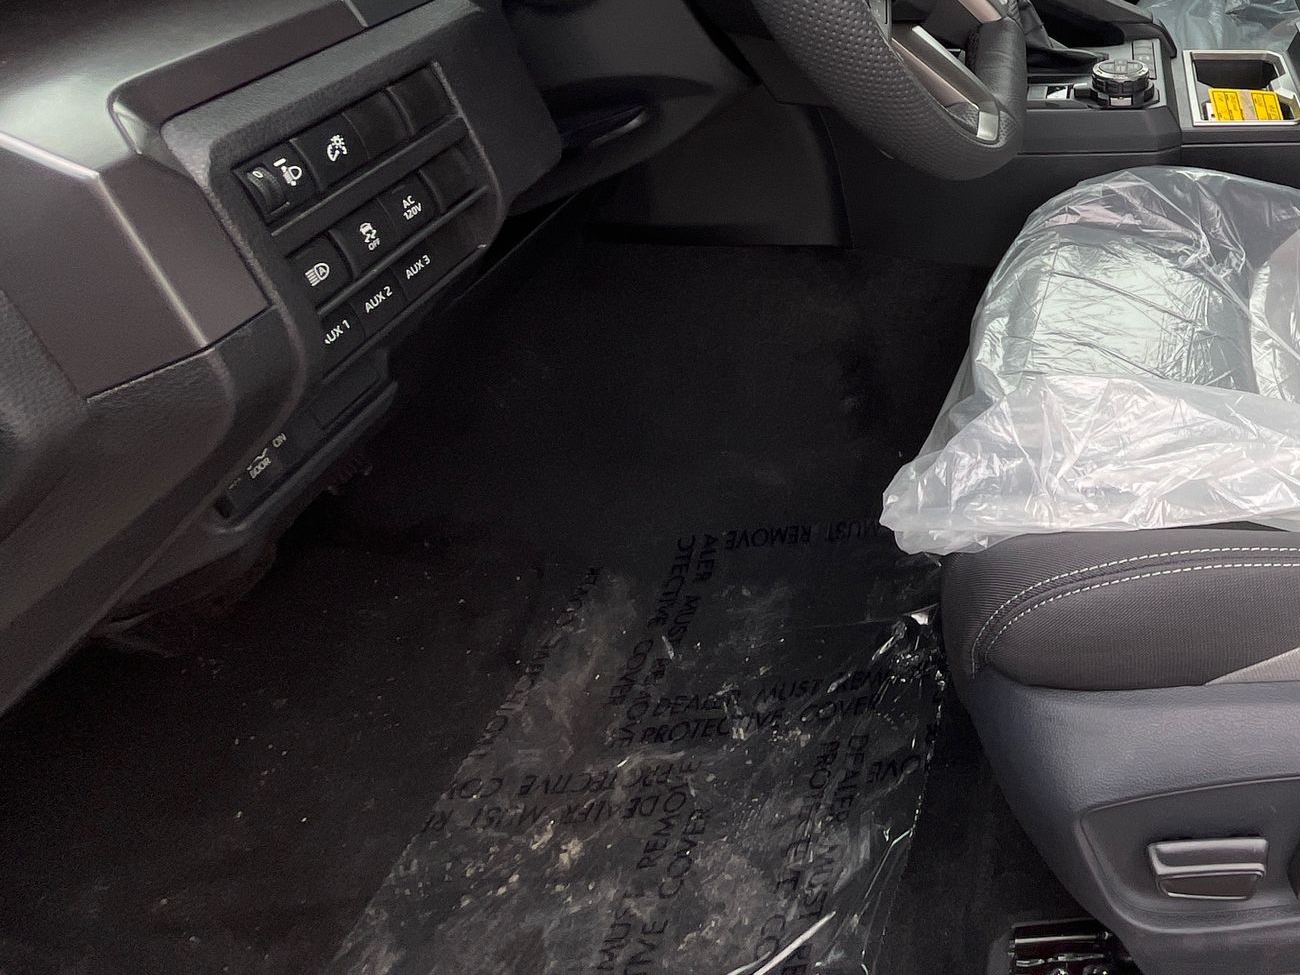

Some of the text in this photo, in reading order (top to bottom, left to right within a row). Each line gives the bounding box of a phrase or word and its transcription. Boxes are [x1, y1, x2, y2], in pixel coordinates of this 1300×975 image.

[402, 195, 415, 209] AC
[402, 202, 423, 220] 120V
[368, 238, 381, 251] OFF
[405, 254, 432, 280] AUX 3
[363, 286, 393, 314] AUX 2
[323, 319, 352, 345] UX 1
[725, 525, 812, 551] REMOVE
[754, 679, 822, 706] MUST
[639, 706, 785, 745] PROTECIVE
[657, 808, 712, 901] COVER
